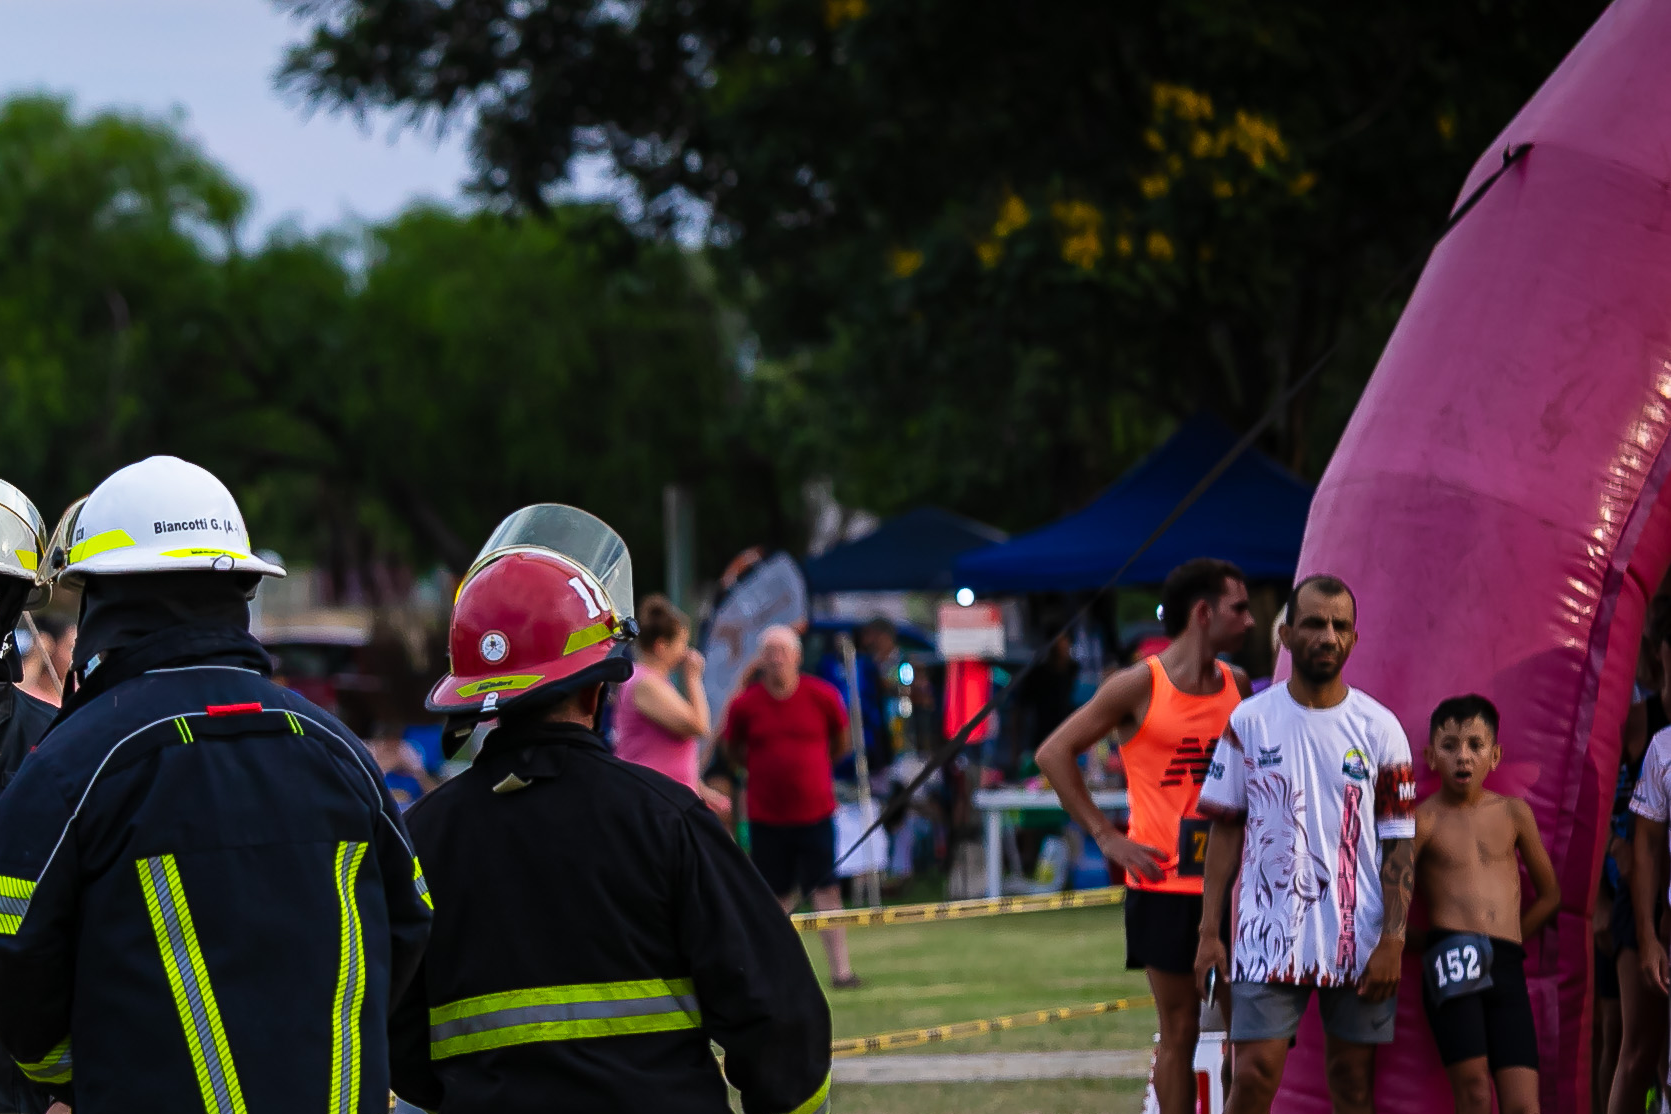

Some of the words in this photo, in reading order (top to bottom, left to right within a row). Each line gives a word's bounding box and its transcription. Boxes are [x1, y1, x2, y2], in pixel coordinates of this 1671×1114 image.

[154, 518, 208, 534] Biancotti
[211, 518, 222, 530] G.
[1435, 944, 1481, 988] 152
